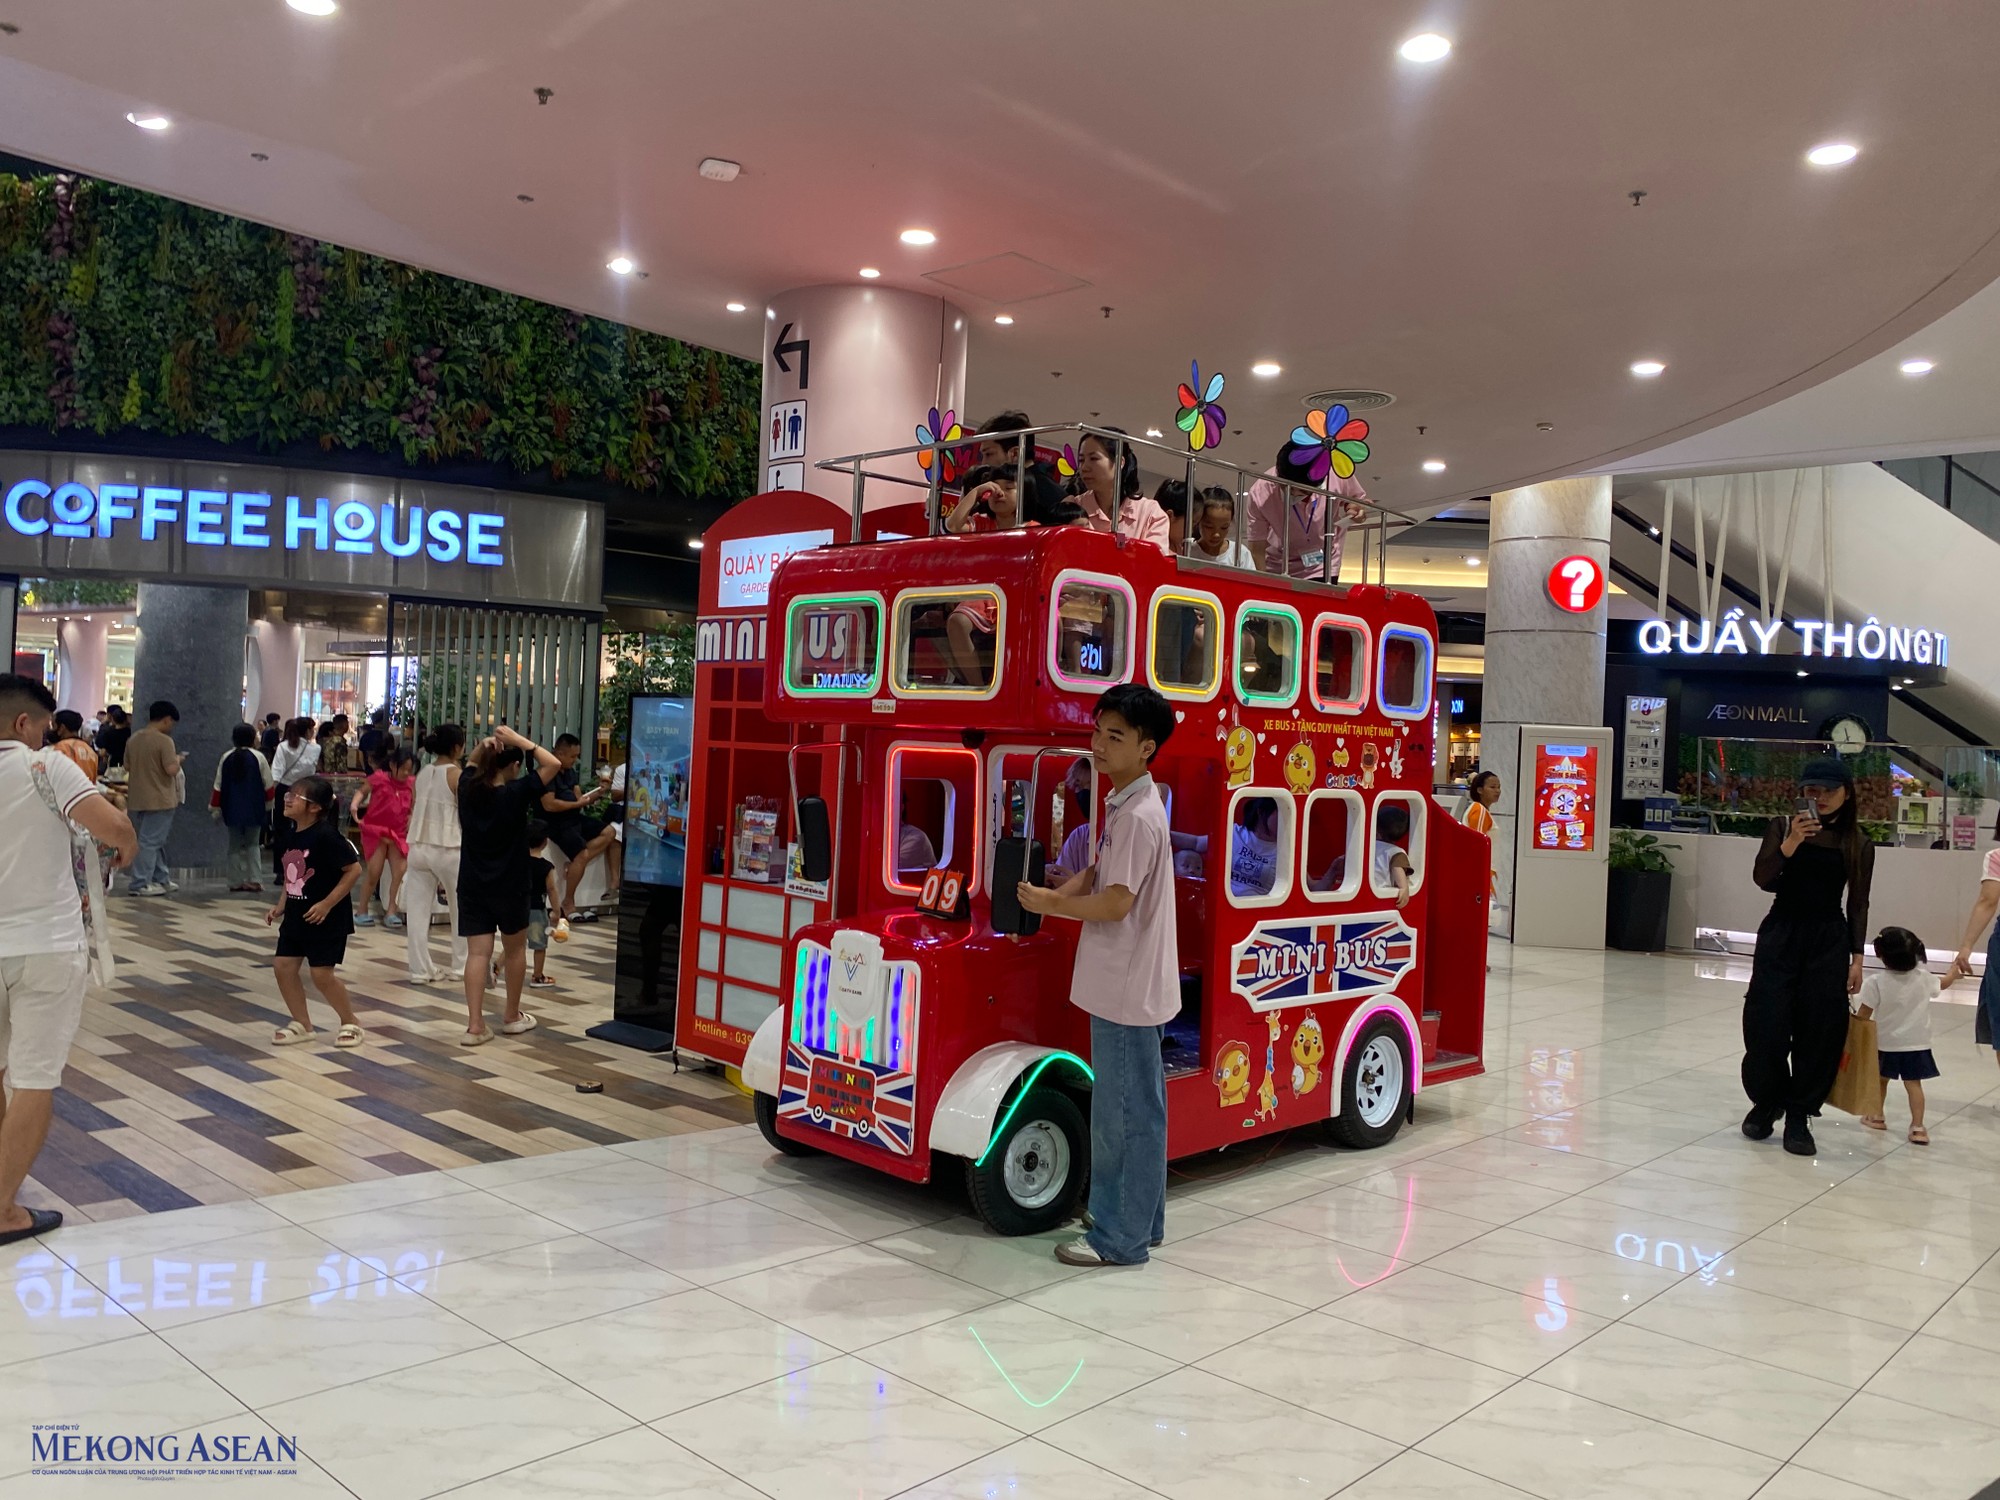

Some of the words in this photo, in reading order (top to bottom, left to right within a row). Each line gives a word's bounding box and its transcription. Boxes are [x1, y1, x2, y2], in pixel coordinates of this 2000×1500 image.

[4, 479, 272, 548] COFFEE
[285, 497, 504, 566] HOUSE
[740, 582, 769, 594] GARDE
[697, 617, 767, 662] MINI
[808, 614, 847, 661] US
[1637, 608, 1783, 654] QUẦY
[1795, 617, 1931, 664] THÔNG
[1264, 720, 1273, 730] XE
[1275, 720, 1290, 731] BUS
[1291, 722, 1296, 731] 2
[1298, 718, 1317, 733] TẦNG
[1317, 722, 1332, 733] DUY
[1333, 721, 1351, 735] NHẤT
[1352, 726, 1363, 737] TẠI
[1363, 724, 1378, 739] VIỆT
[1378, 728, 1394, 738] NAM
[1757, 706, 1808, 723] MALL
[922, 875, 958, 909] 09
[1256, 941, 1328, 979] MINI
[1334, 936, 1388, 971] BUS
[695, 1019, 728, 1039] Hotline
